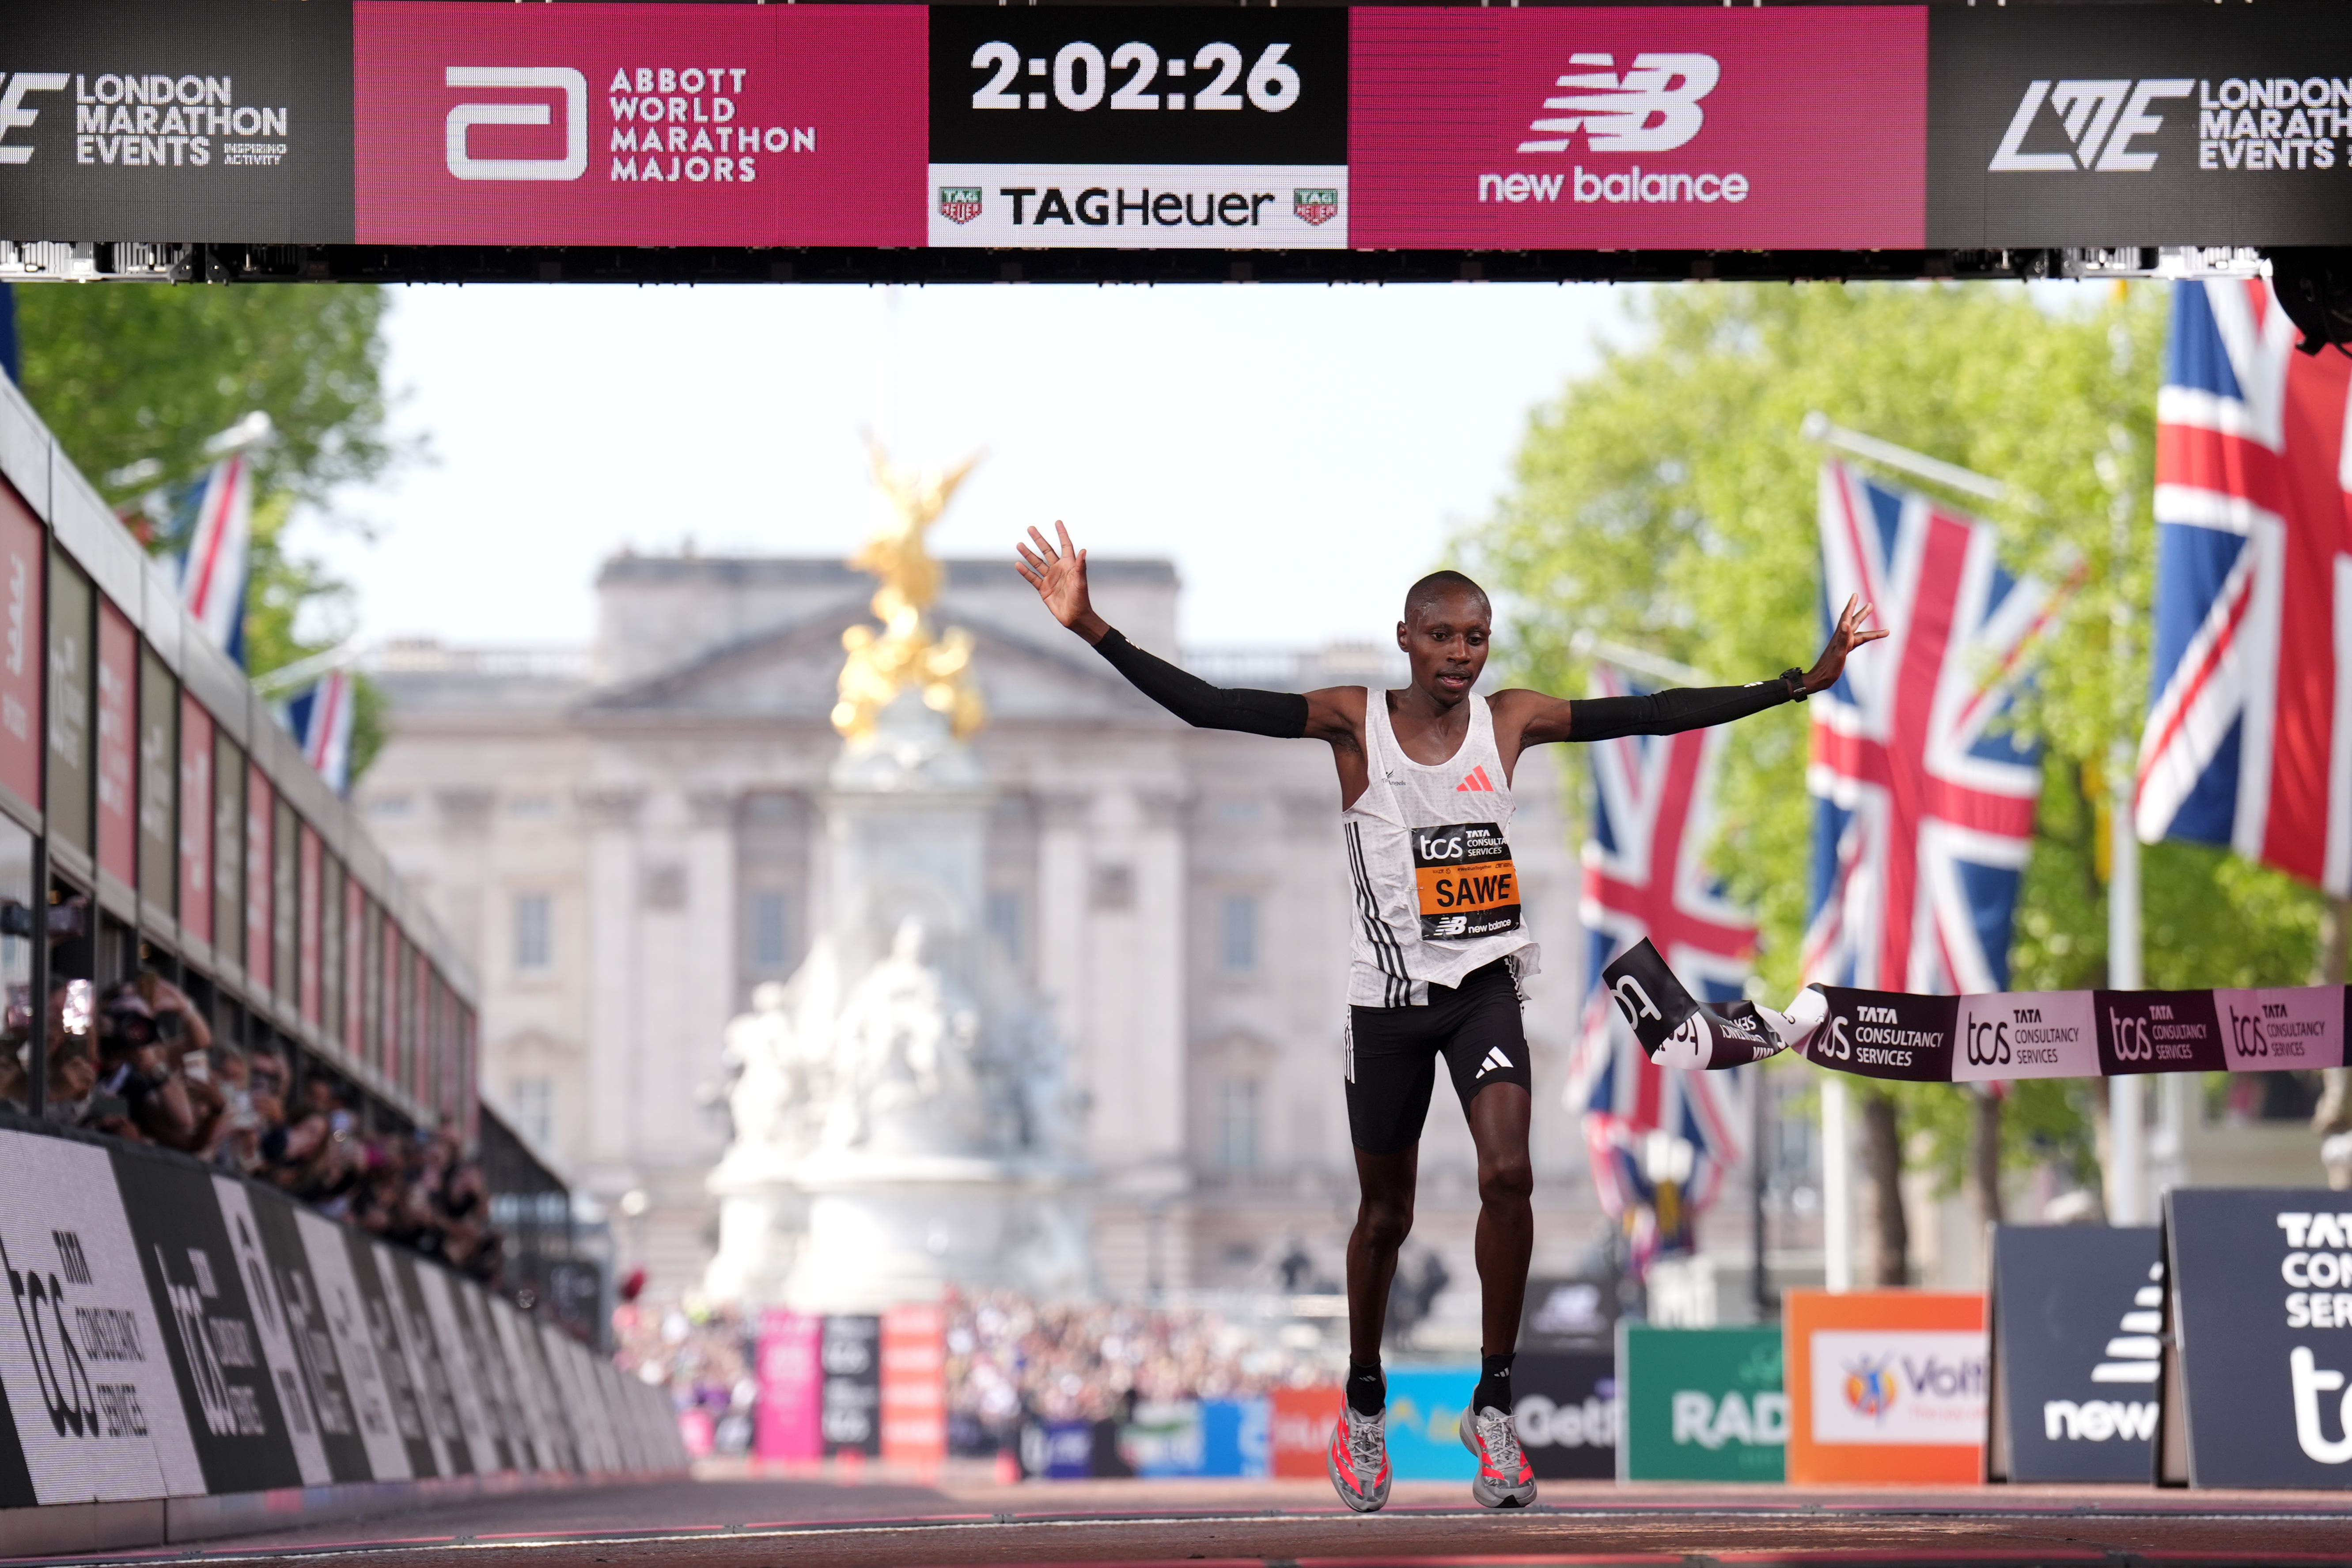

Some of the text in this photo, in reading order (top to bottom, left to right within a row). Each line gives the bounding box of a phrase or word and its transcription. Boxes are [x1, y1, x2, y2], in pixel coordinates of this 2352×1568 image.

[610, 68, 746, 93] ABBOTT
[971, 41, 1300, 112] 2:02:26
[76, 73, 231, 105] LONDON
[2199, 77, 2352, 109] LONDON
[610, 96, 736, 123] WORLD
[76, 105, 287, 136] MARATHON
[610, 126, 817, 153] MARATHON
[76, 135, 211, 166] EVENTS
[224, 155, 281, 165] ACTIVITY
[2199, 137, 2335, 170] EVENTS
[610, 155, 756, 182] MAJORS
[1478, 165, 1750, 203] new balance
[943, 190, 979, 202] TAG
[1299, 191, 1333, 203] TAG
[1466, 829, 1490, 838] TATA
[1420, 835, 1463, 860] tcs
[1468, 847, 1502, 857] SERVICES
[1436, 874, 1511, 907] SAWE
[1468, 919, 1511, 934] new balance
[1856, 1005, 1898, 1025] TATA
[2013, 1008, 2042, 1024] TATA
[2148, 1005, 2174, 1021] TATA
[2261, 1004, 2287, 1019] TATA
[1855, 1026, 1944, 1048] CONSULTANCY
[1968, 1011, 2011, 1065] tcs
[2014, 1027, 2079, 1044] CONSULTANCY
[2109, 1005, 2153, 1061] tcs
[2151, 1023, 2207, 1041] CONSULTANCY
[2229, 1004, 2268, 1058] tcs
[2266, 1020, 2325, 1038] CONSULTANCY
[1856, 1047, 1913, 1067] SERVICES
[2016, 1048, 2058, 1064] SERVICES
[2155, 1043, 2193, 1060] SERVICES
[2270, 1041, 2305, 1058] SERVICES
